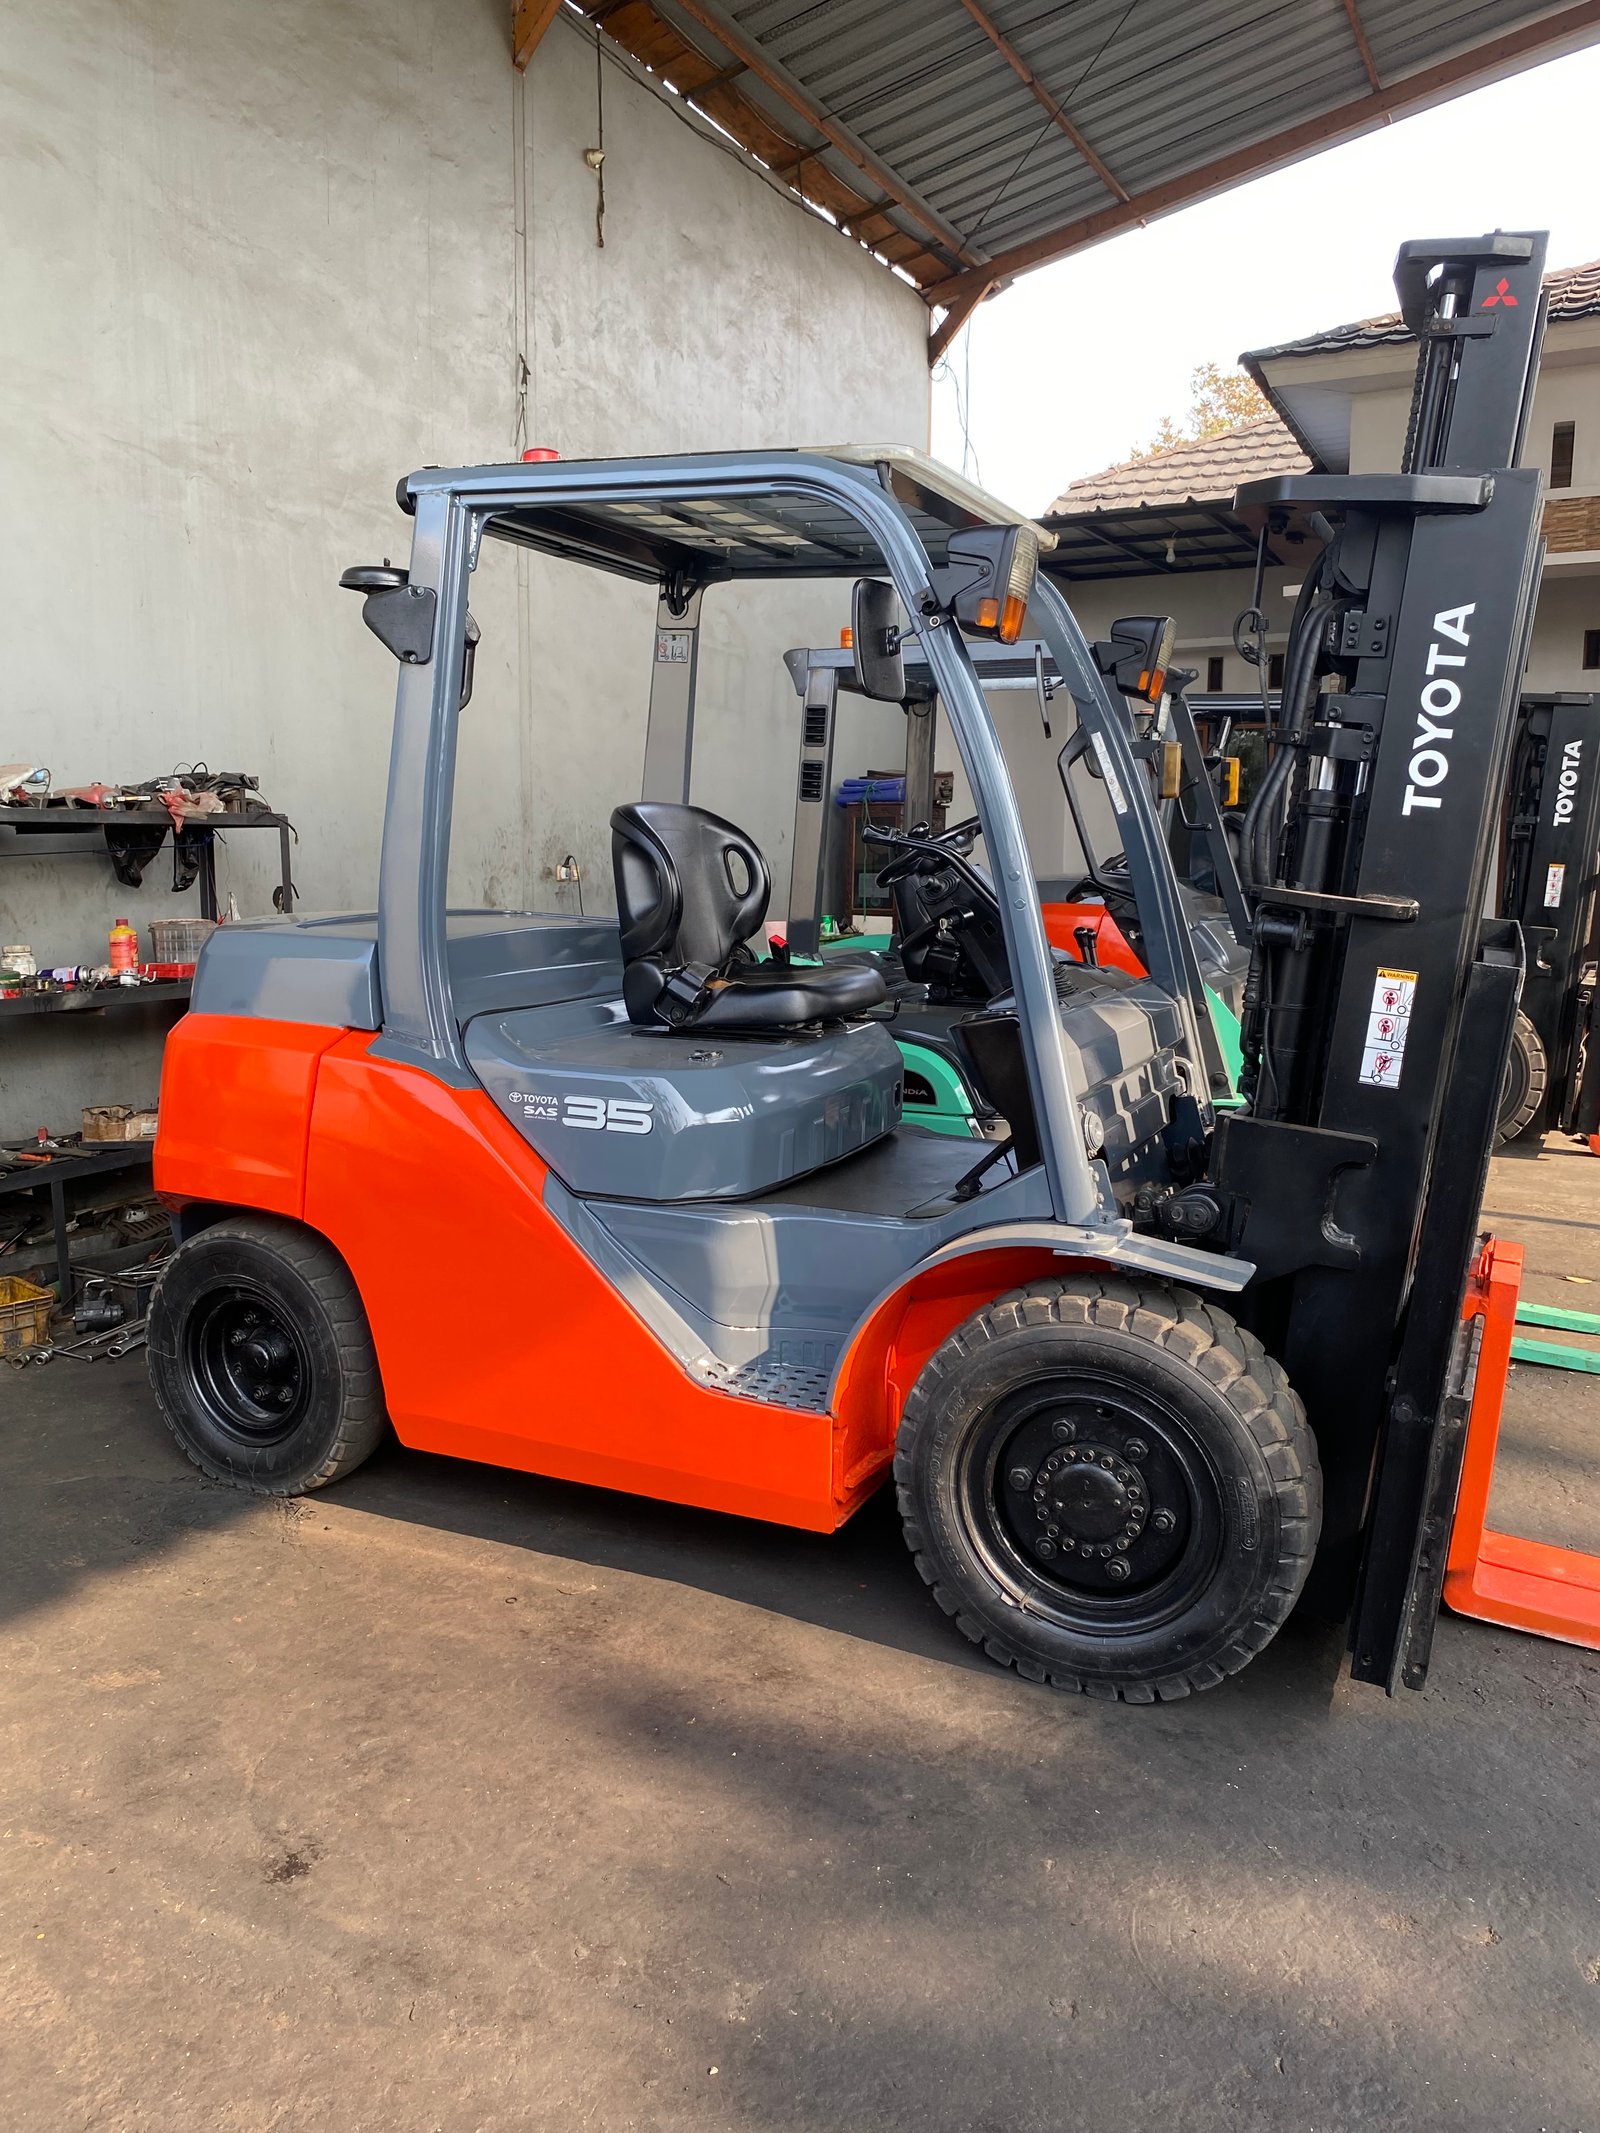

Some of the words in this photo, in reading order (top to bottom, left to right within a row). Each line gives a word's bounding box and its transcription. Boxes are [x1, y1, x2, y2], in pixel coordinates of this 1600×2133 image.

[1401, 602, 1476, 816] TOYOTA
[1553, 739, 1583, 827] TOYOTA
[1386, 971, 1415, 981] WARNING
[522, 1094, 559, 1106] TOYOTA
[523, 1105, 558, 1117] SAS
[562, 1095, 654, 1135] 35
